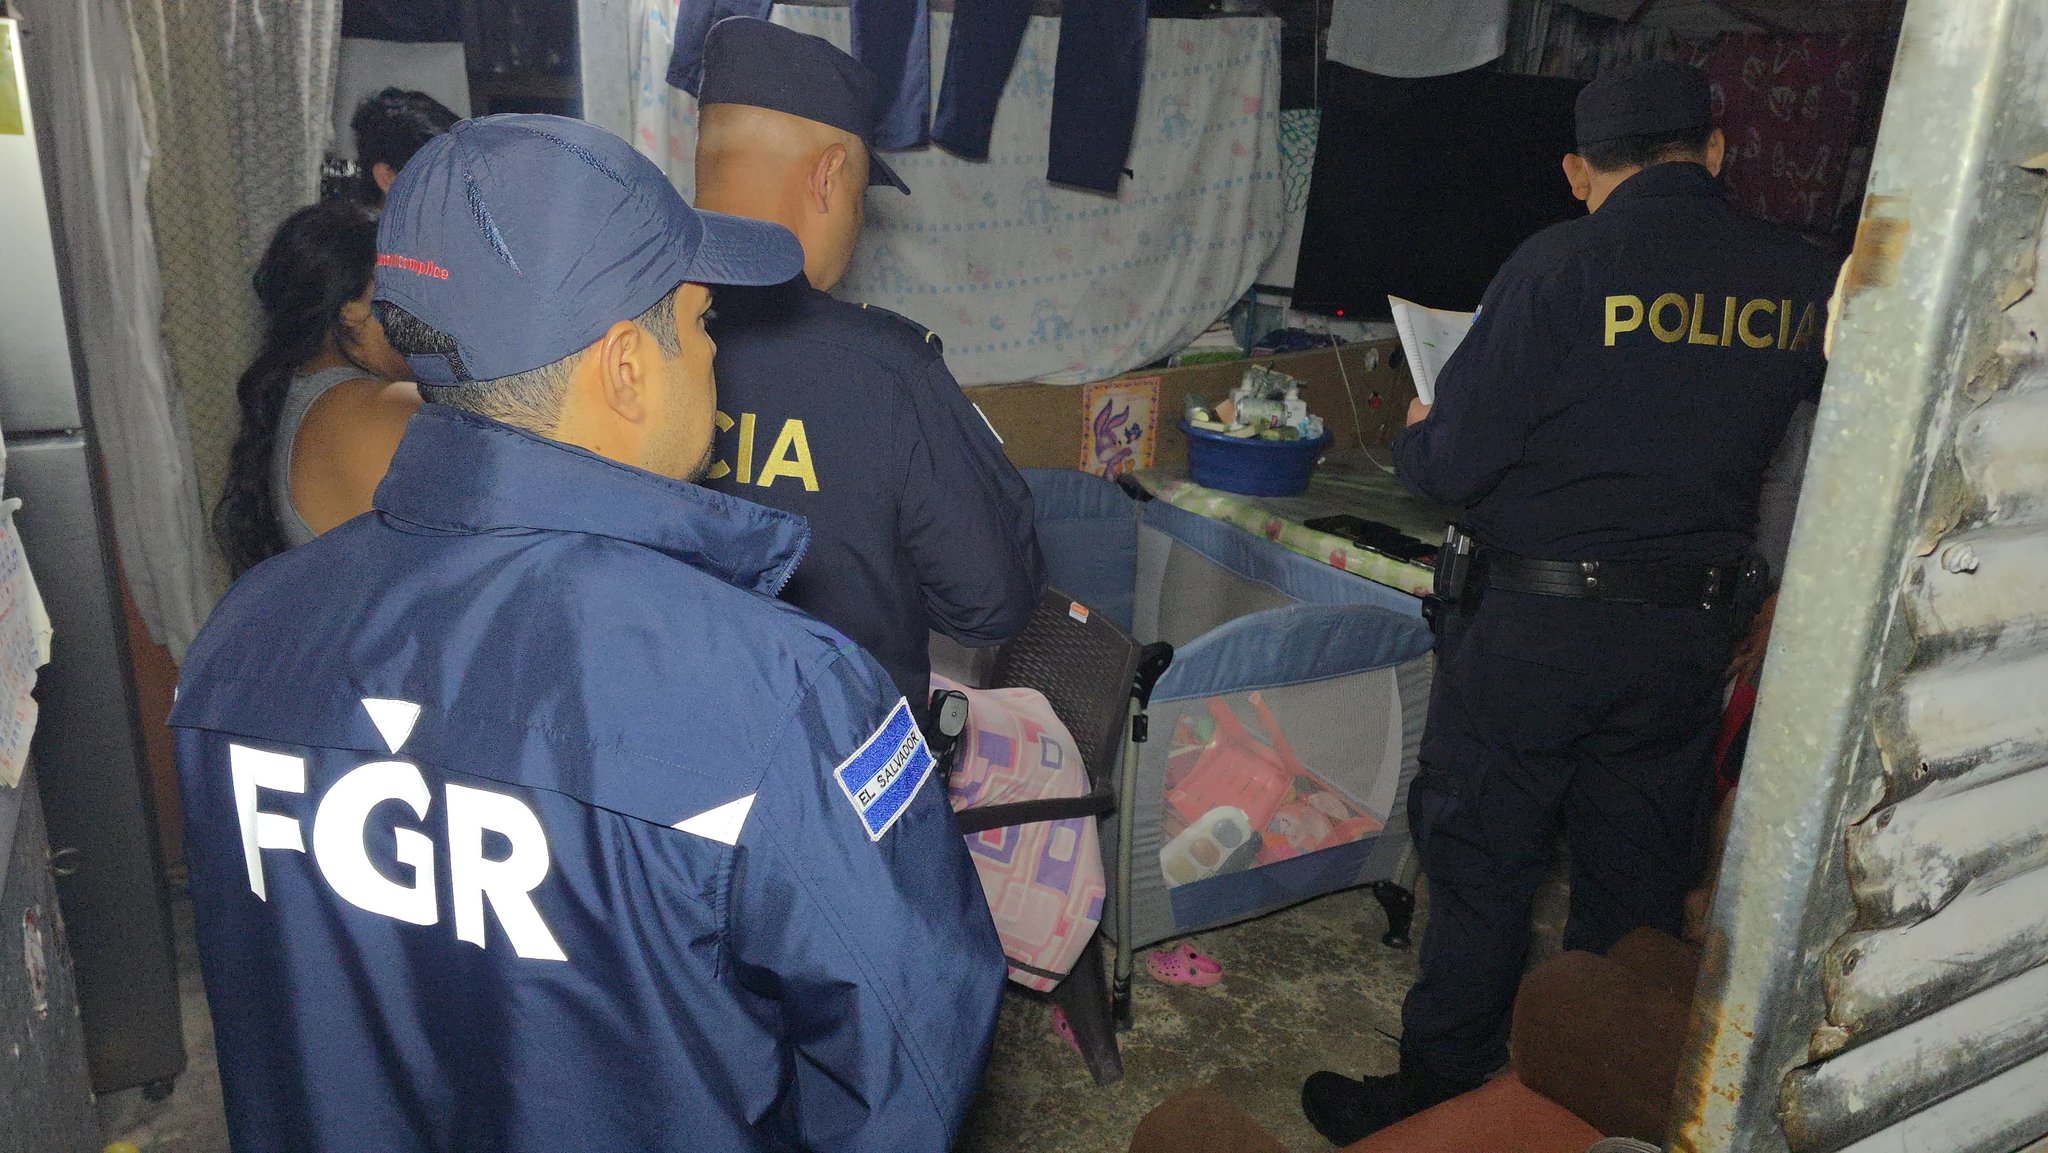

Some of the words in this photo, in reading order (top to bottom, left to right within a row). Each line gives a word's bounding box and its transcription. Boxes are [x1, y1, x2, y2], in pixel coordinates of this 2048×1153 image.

[1604, 292, 1816, 351] POLICIA
[858, 788, 876, 806] EL
[876, 730, 920, 788] SALVADOR
[229, 742, 569, 962] FGR
